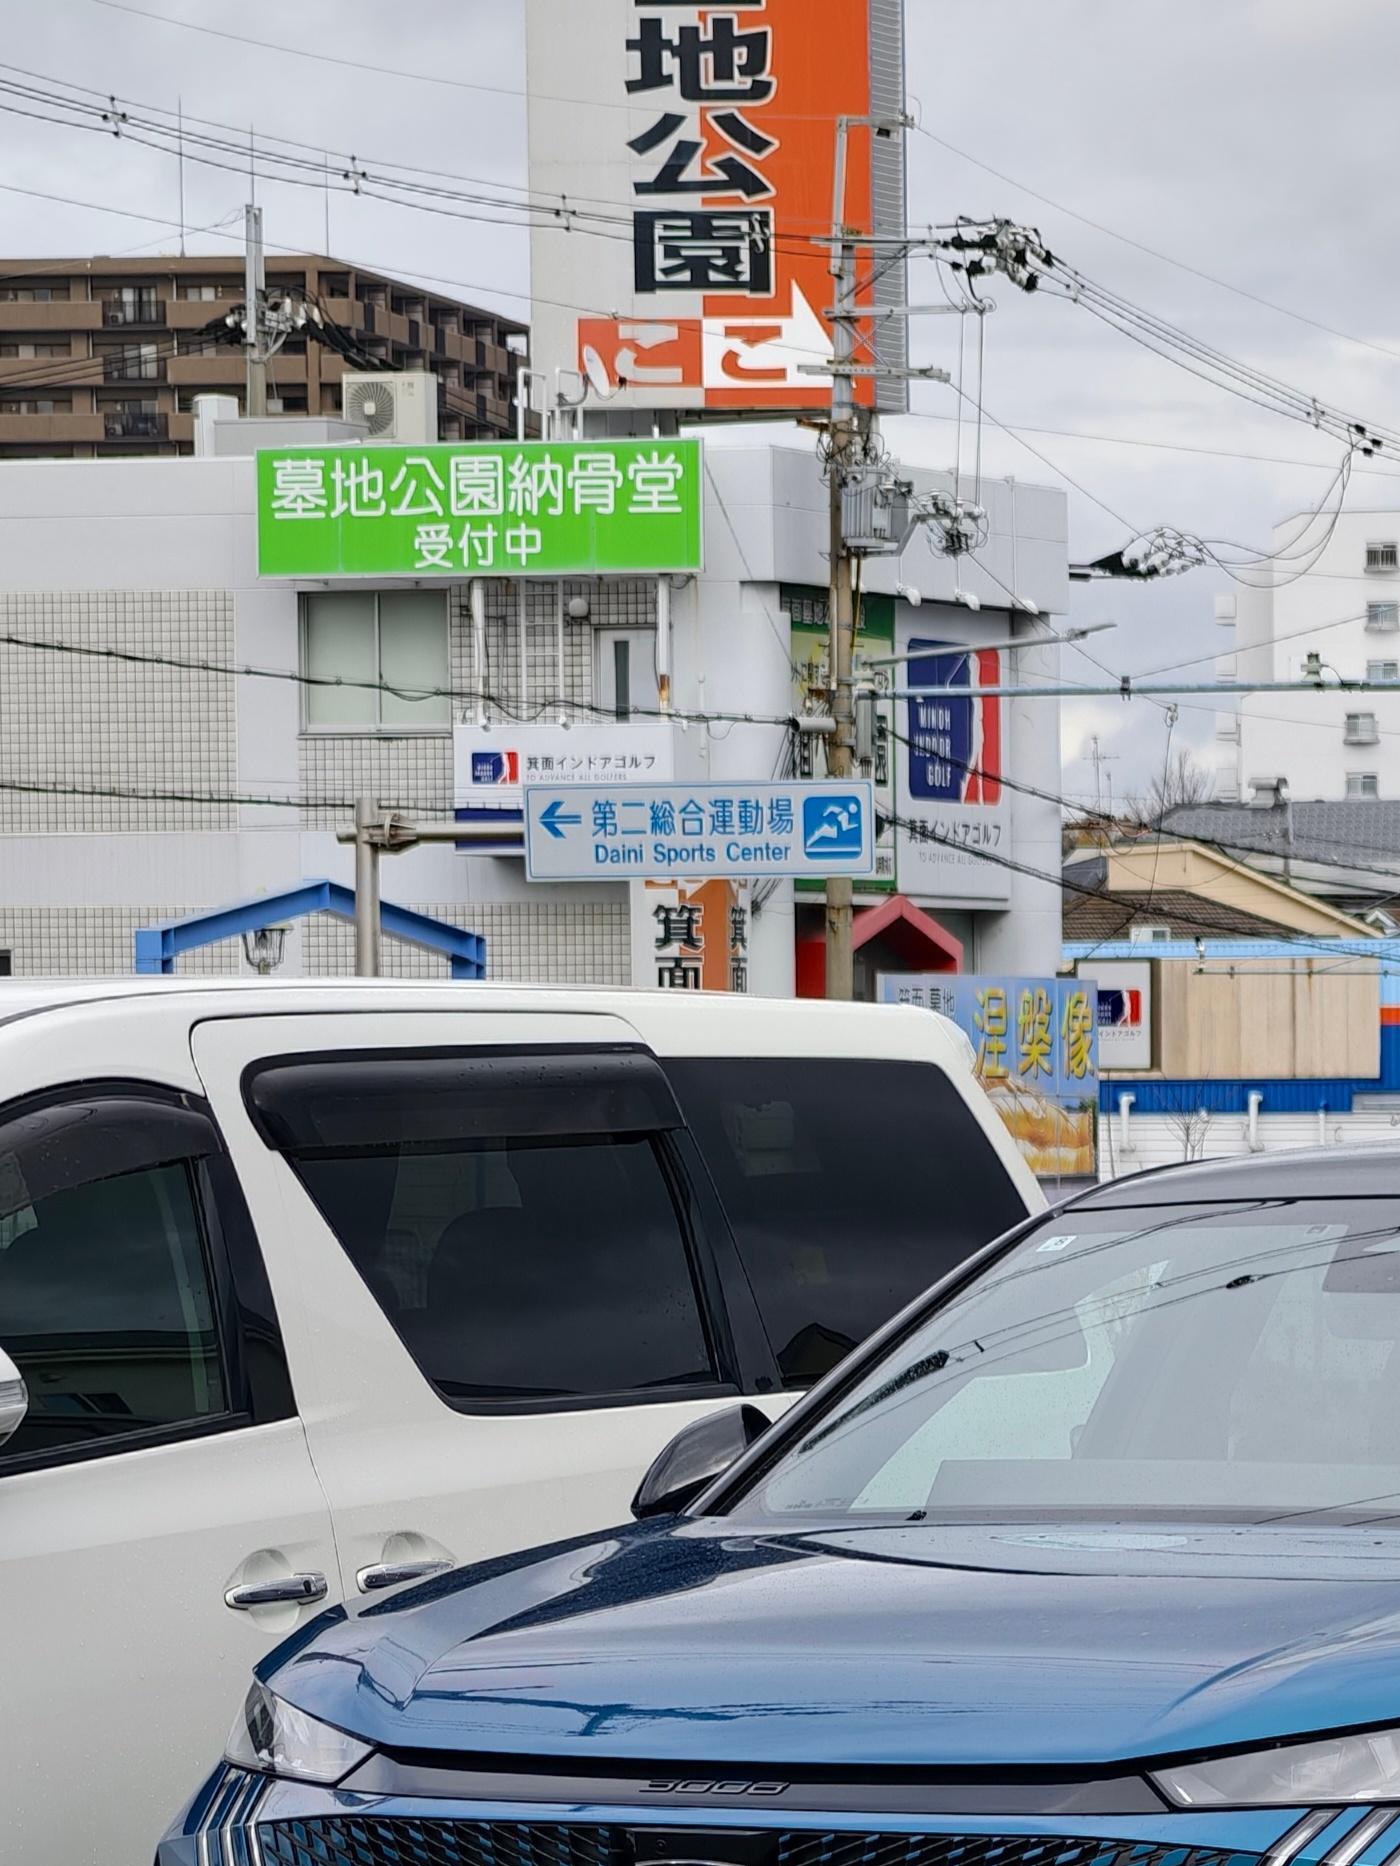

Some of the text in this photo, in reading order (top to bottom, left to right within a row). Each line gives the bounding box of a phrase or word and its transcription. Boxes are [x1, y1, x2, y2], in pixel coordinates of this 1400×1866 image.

[624, 0, 778, 294] 地公園
[271, 452, 684, 520] 墓地公園納骨堂
[413, 523, 543, 568] 受付中
[527, 756, 656, 771] 箕面インドアゴルフ
[926, 765, 951, 788] GOLF
[591, 797, 795, 837] 第二総合運動場
[594, 842, 791, 867] Daini Sports Center
[973, 985, 1094, 1080] 涅槃像
[639, 1779, 790, 1796] 3008
